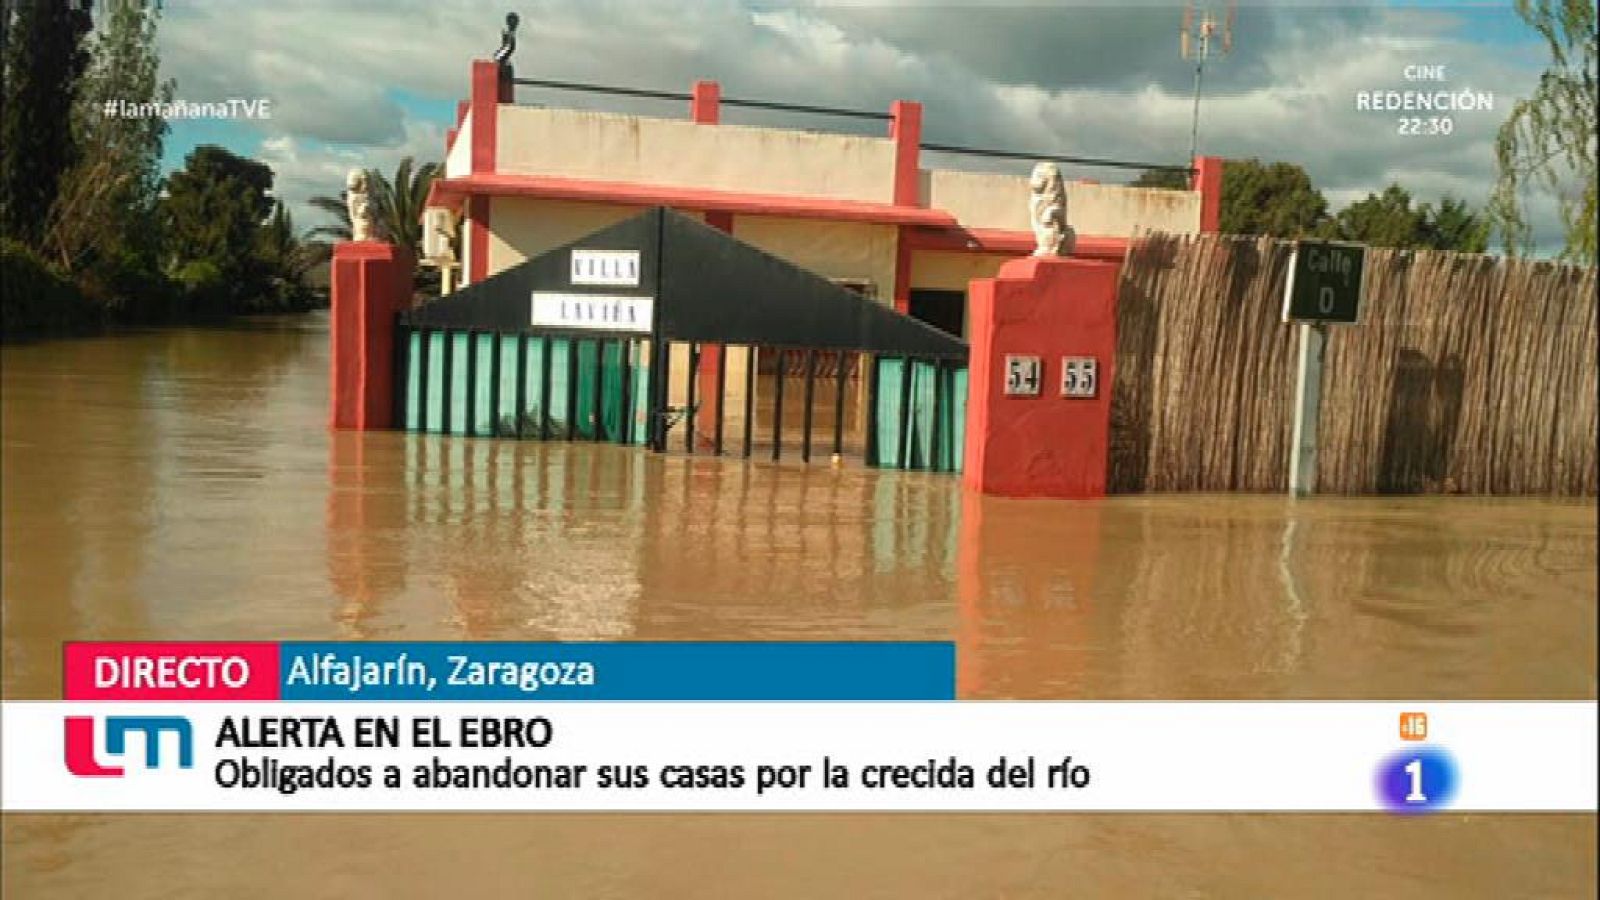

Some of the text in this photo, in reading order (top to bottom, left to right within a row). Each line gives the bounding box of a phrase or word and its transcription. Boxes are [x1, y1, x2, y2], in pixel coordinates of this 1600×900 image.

[574, 258, 637, 278] VILLA
[1307, 249, 1352, 273] Calle
[1008, 360, 1093, 392] 54 55
